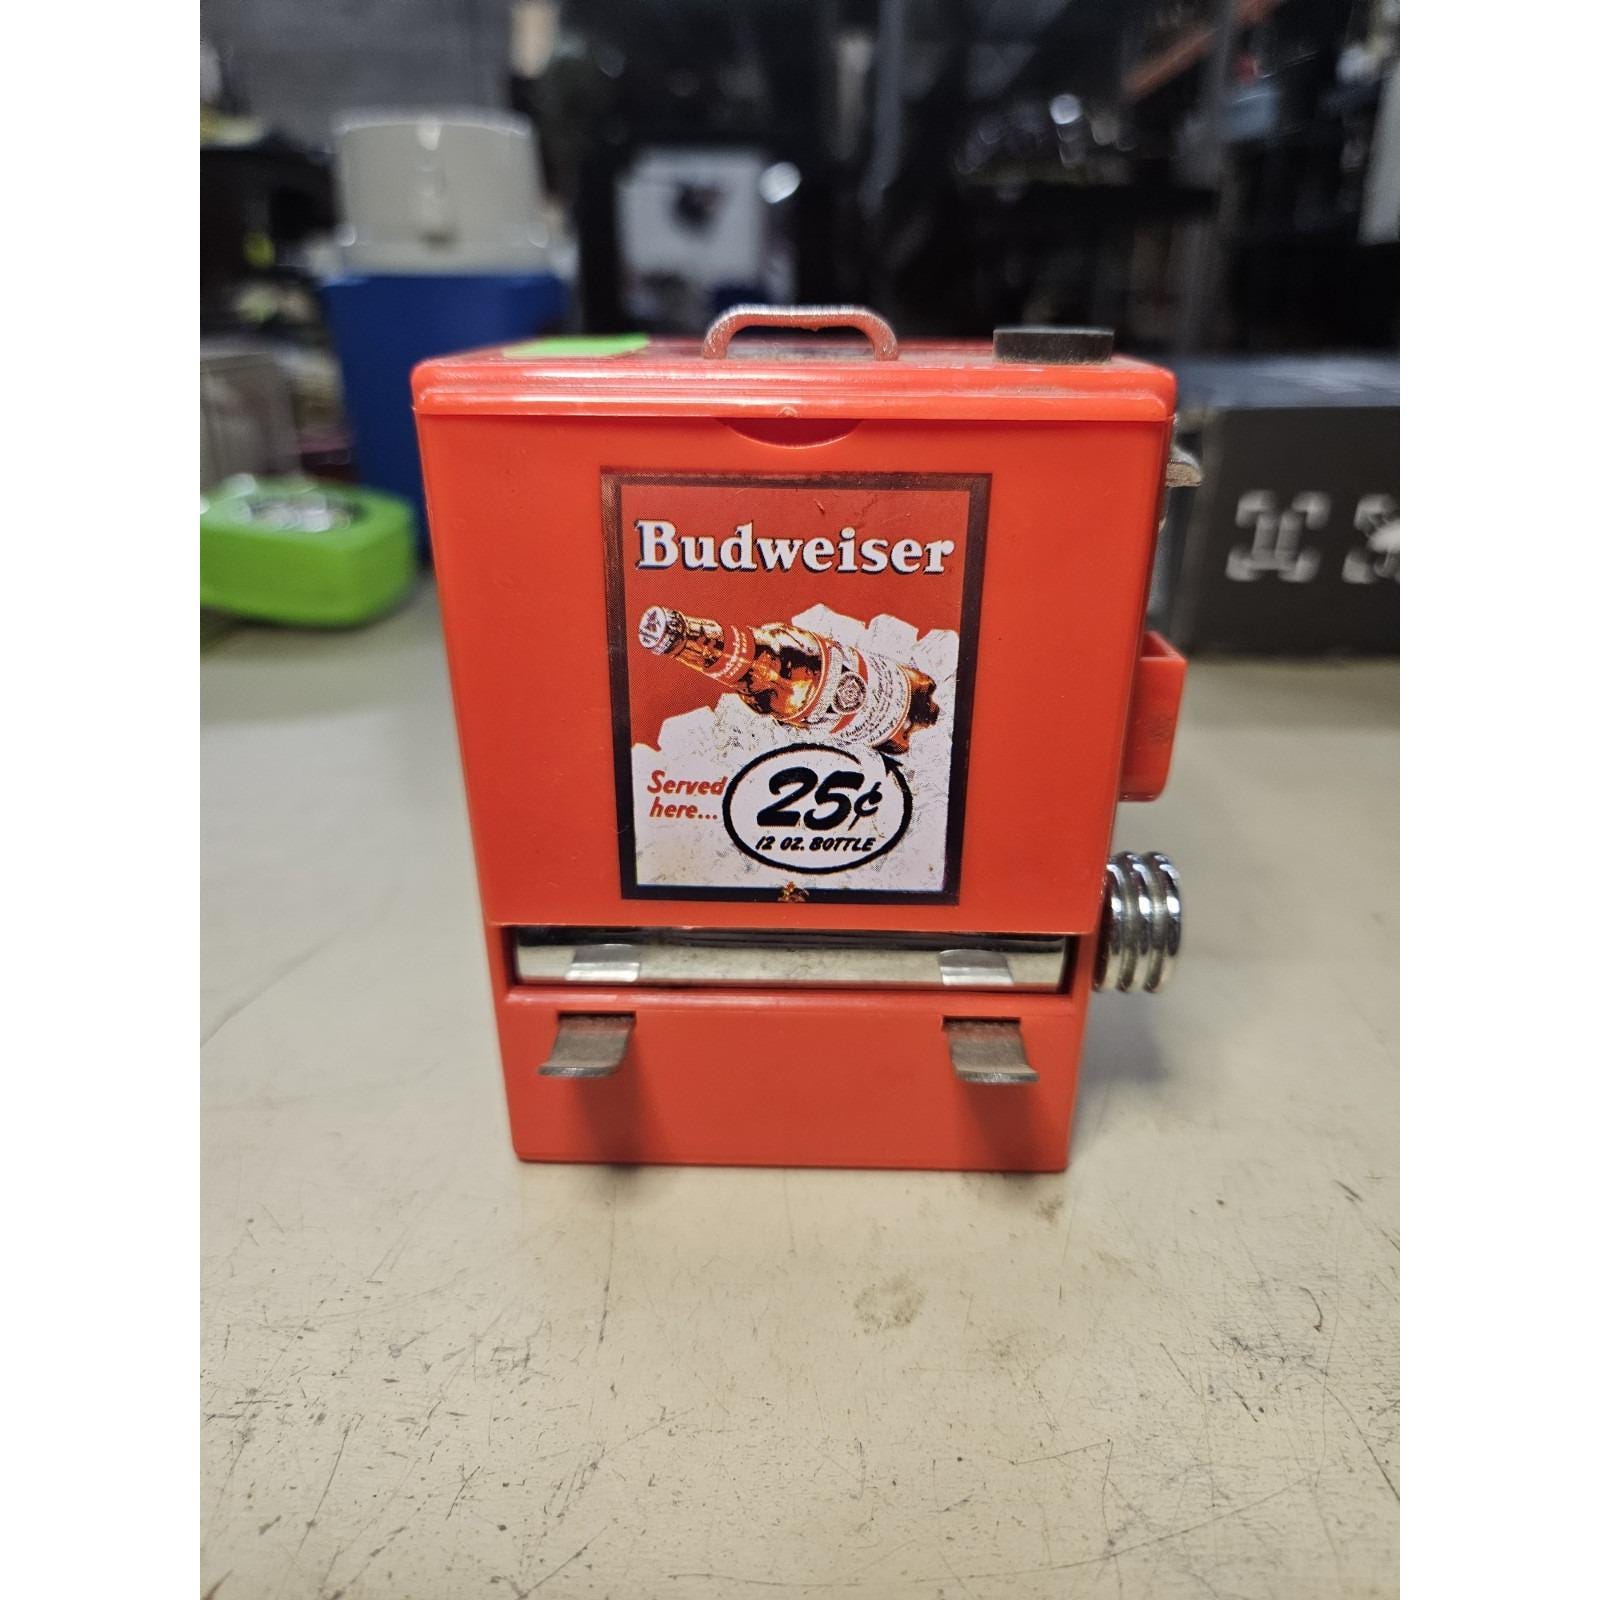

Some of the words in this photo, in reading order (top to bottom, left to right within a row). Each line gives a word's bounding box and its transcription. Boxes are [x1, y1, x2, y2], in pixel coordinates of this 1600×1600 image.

[635, 518, 955, 575] Budweiser
[647, 769, 728, 795] Served
[649, 796, 718, 819] here...
[757, 766, 882, 831] 25¢
[755, 836, 776, 850] 12
[780, 837, 804, 851] OZ.
[809, 837, 876, 851] BOTTLE
